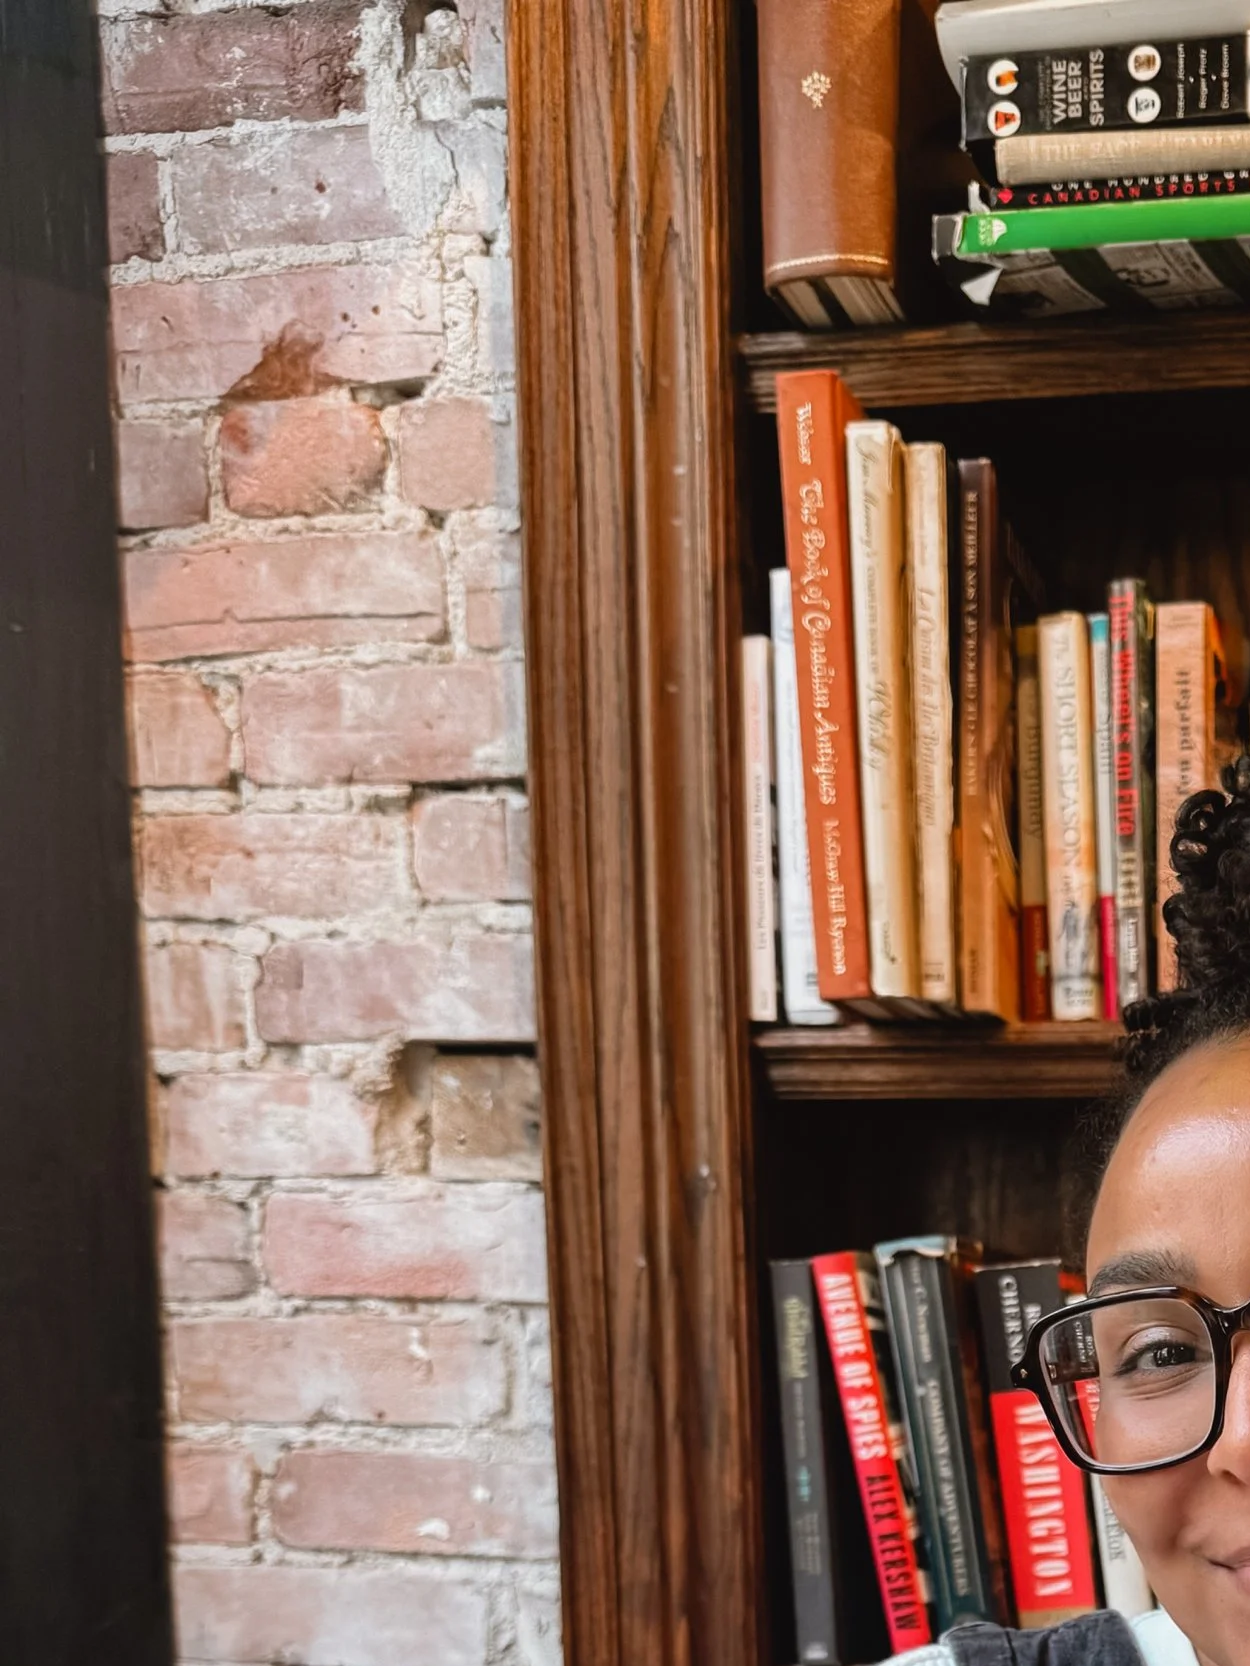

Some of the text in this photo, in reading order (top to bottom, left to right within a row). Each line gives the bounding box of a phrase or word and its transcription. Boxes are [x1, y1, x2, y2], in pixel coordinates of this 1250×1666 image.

[1053, 60, 1067, 123] WINE
[1067, 62, 1082, 118] BEER
[1089, 49, 1104, 126] SPIRITS
[1028, 185, 1141, 205] CANADIAN
[1156, 179, 1236, 197] SPORTS
[799, 479, 840, 806] The Book of Canadian Antiques
[964, 616, 977, 699] CHOCOLAT
[1106, 590, 1140, 835] This Wheel's on Fire
[1175, 669, 1193, 750] parfait
[1054, 666, 1082, 867] SHORT SEASON
[999, 1275, 1023, 1362] CHERNO
[821, 1273, 921, 1631] AVENUE OF SPIES ALEX KERSHAW
[925, 1378, 971, 1596] COMPANY OF ADVENTURERS
[1013, 1402, 1073, 1597] WASHINGTON
